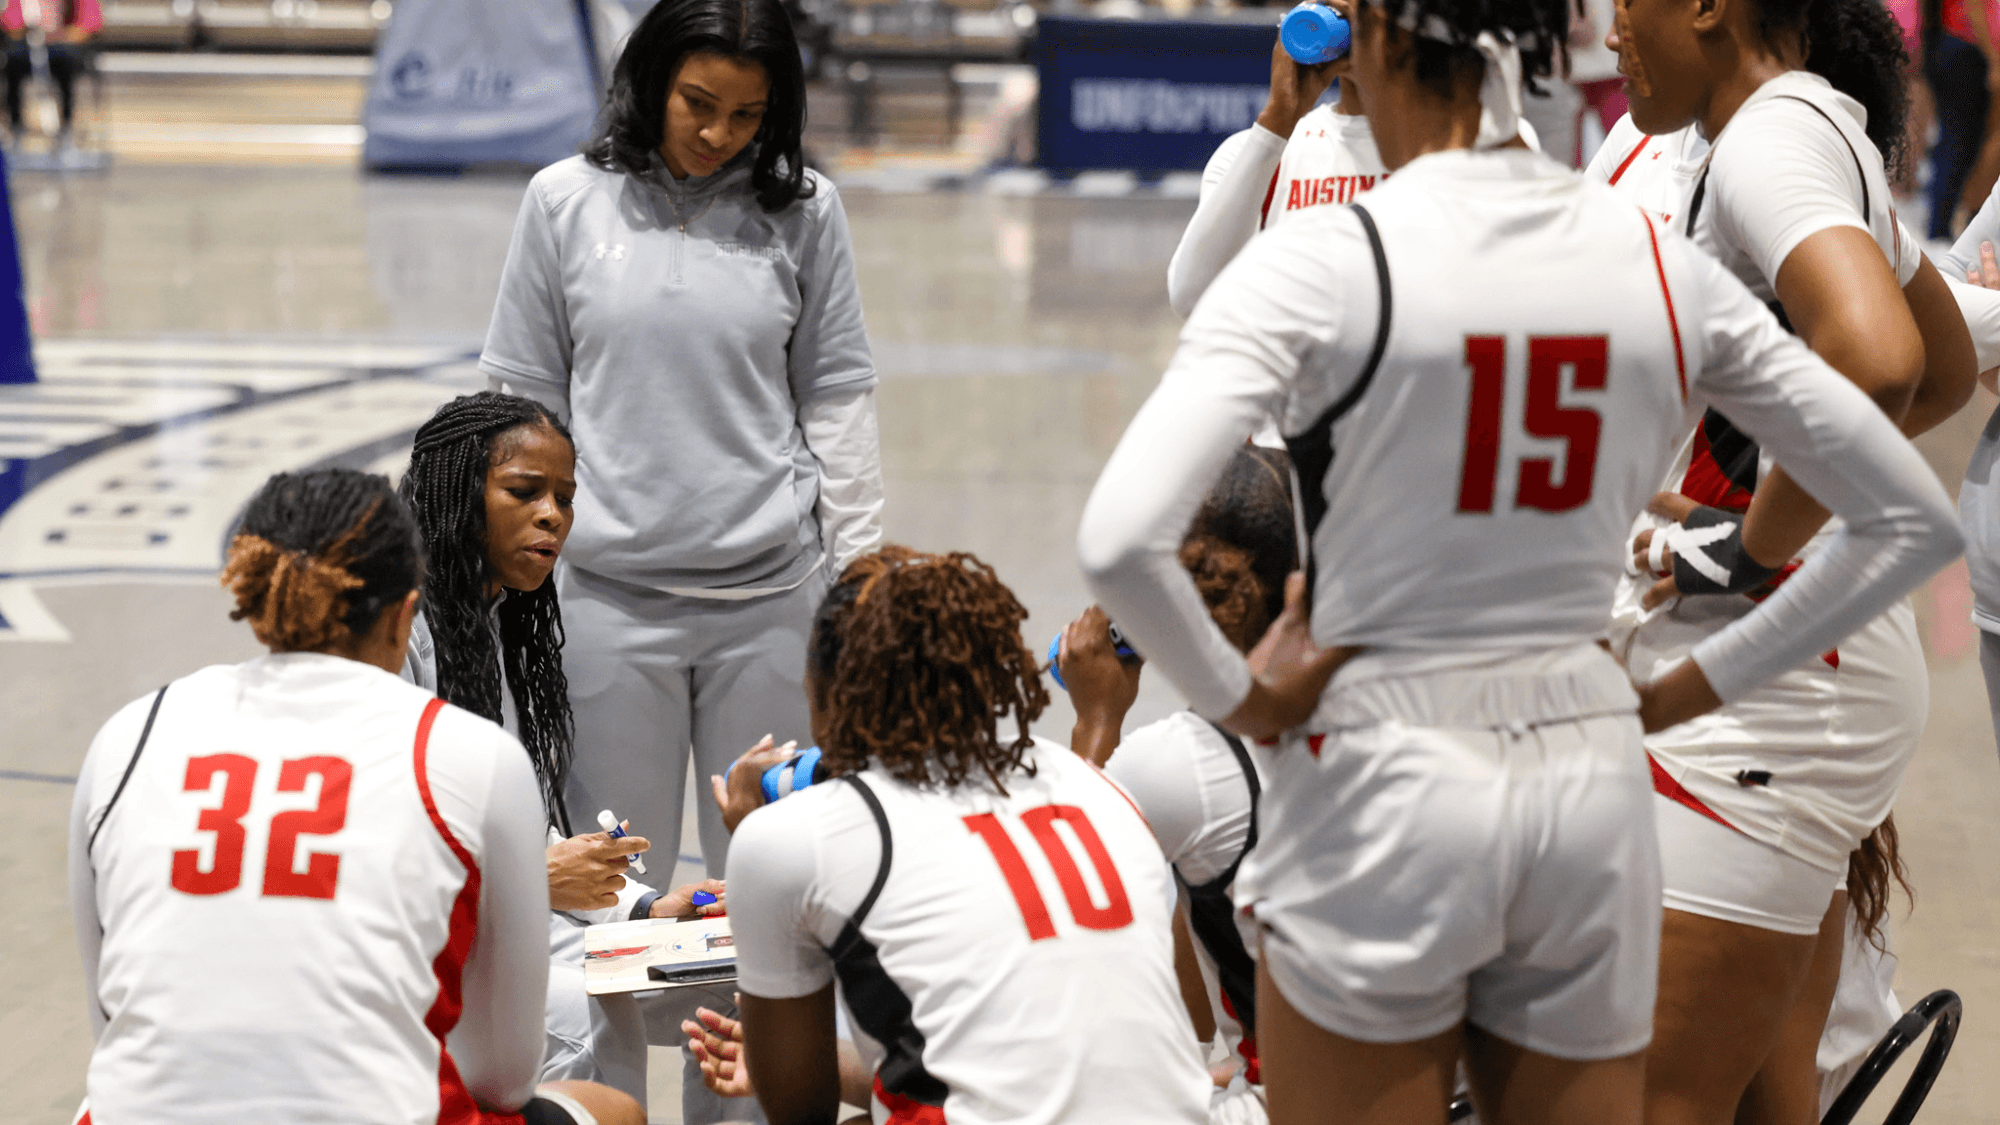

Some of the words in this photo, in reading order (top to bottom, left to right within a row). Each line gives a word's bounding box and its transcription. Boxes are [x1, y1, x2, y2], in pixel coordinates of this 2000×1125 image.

[716, 242, 781, 261] GOVERNORS
[1459, 335, 1609, 513] 15
[170, 752, 354, 902] 32
[961, 803, 1135, 943] 10
